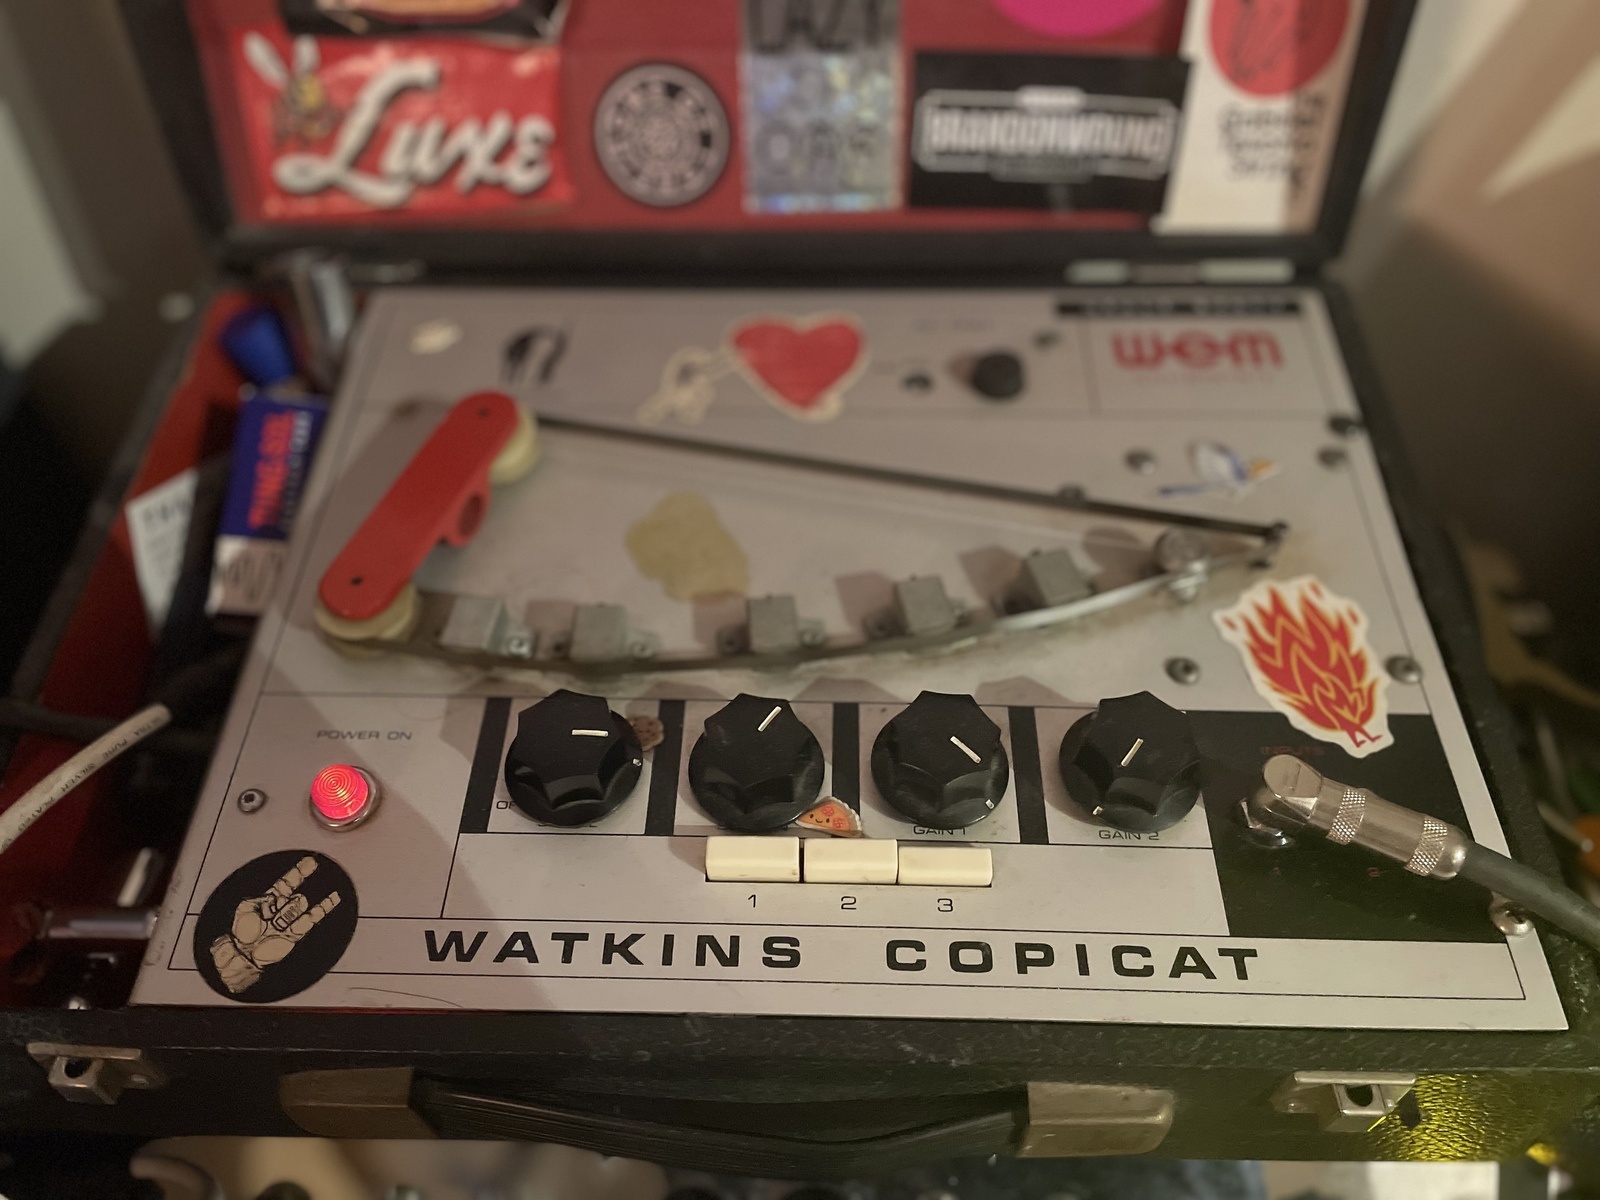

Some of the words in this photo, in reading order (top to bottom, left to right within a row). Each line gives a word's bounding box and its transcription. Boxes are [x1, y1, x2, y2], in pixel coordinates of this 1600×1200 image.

[316, 729, 380, 740] POWER
[387, 730, 413, 741] ON
[747, 894, 758, 909] 1
[840, 896, 858, 911] 2
[937, 898, 954, 912] 3
[424, 930, 802, 968] WATKINS
[886, 938, 1258, 981] COPICAT
